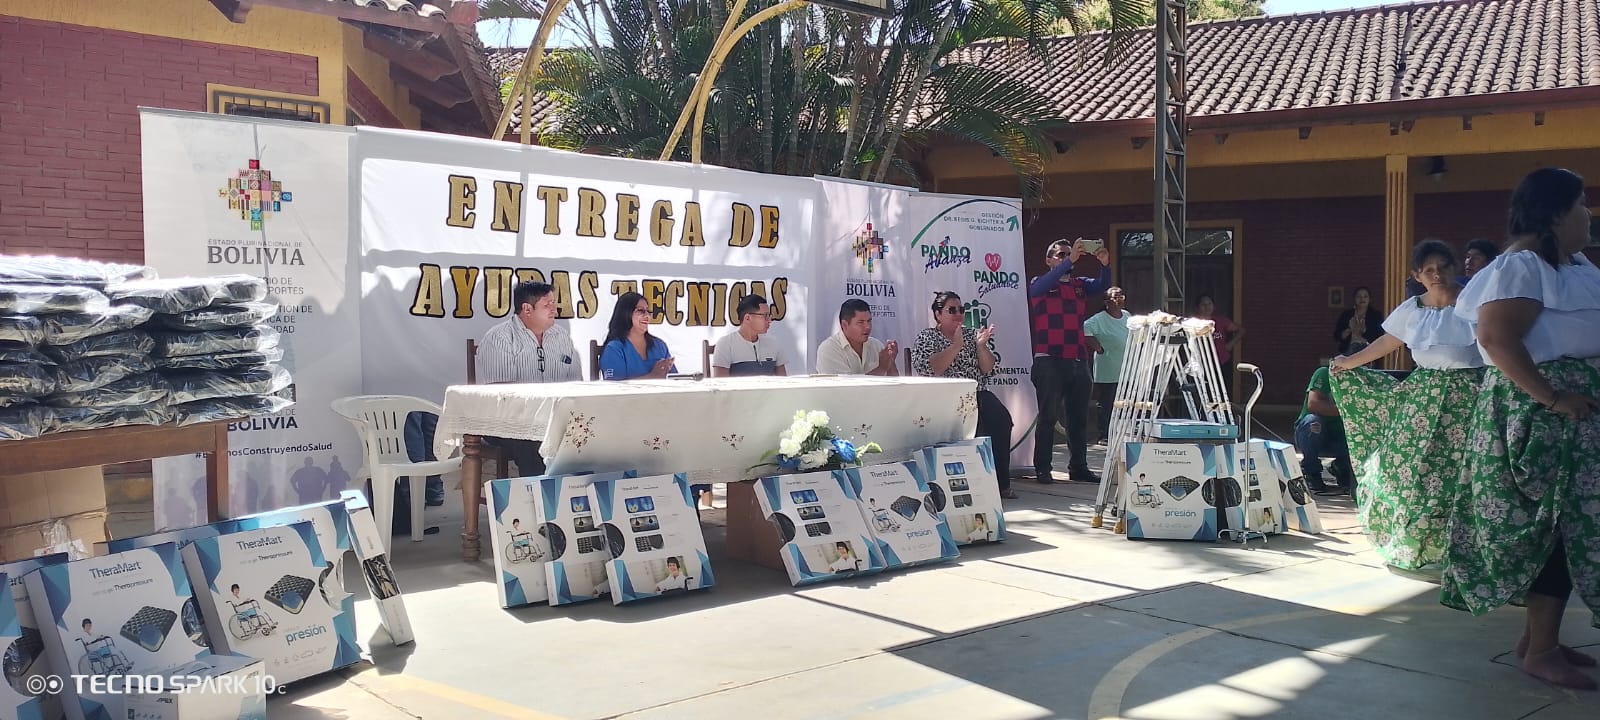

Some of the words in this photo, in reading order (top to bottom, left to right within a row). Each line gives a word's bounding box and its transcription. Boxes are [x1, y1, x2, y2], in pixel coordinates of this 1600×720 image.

[447, 174, 705, 248] ENTREGA
[728, 202, 779, 248] DE
[207, 246, 304, 265] BOLIVIA
[921, 245, 971, 258] PANDO
[974, 270, 1019, 283] PANDO
[267, 287, 304, 295] PORTES
[410, 263, 599, 319] AYUAS
[846, 283, 896, 297] BOLIVIA
[301, 305, 312, 313] DE
[993, 377, 1018, 386] PANDO
[227, 417, 298, 431] BOLIVIA
[236, 535, 283, 550] TheraMart
[89, 561, 142, 579] TheraMart
[286, 624, 327, 646] presión
